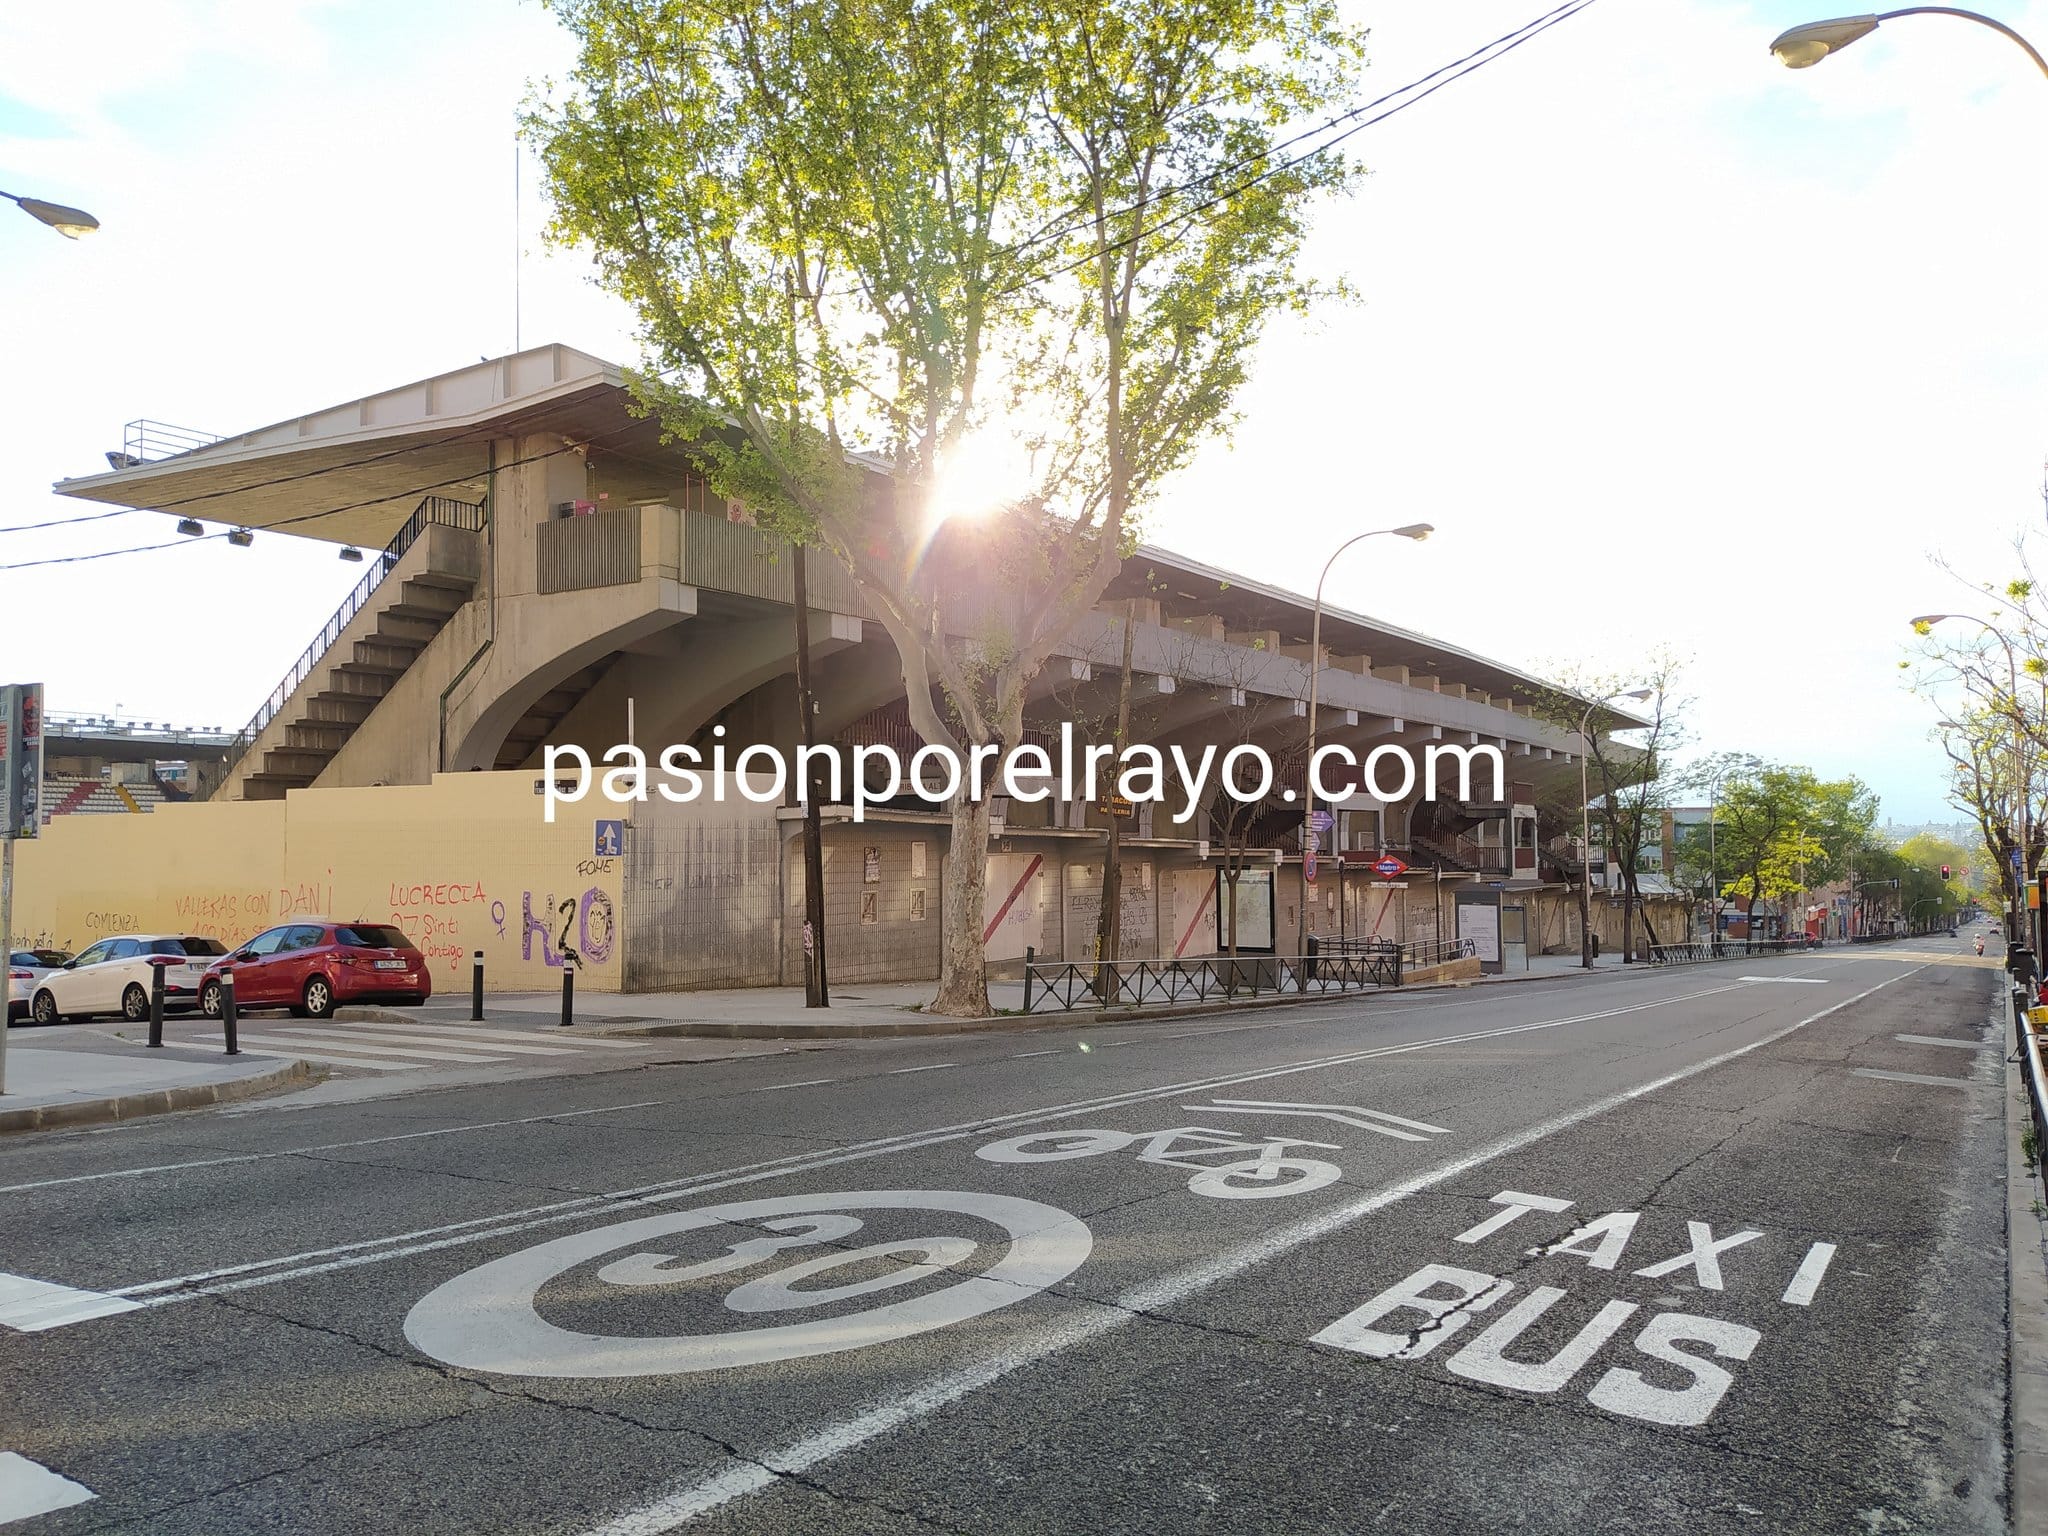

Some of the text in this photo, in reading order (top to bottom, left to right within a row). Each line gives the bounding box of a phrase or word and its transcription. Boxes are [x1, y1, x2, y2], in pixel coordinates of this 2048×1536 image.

[244, 889, 271, 916] CON
[390, 881, 487, 907] LUCRECIA
[85, 911, 140, 931] COMIENZA
[420, 936, 464, 970] Contigo
[598, 1214, 979, 1312] 30
[1453, 1190, 1838, 1306] TAXI
[1308, 1263, 1762, 1427] BUS
